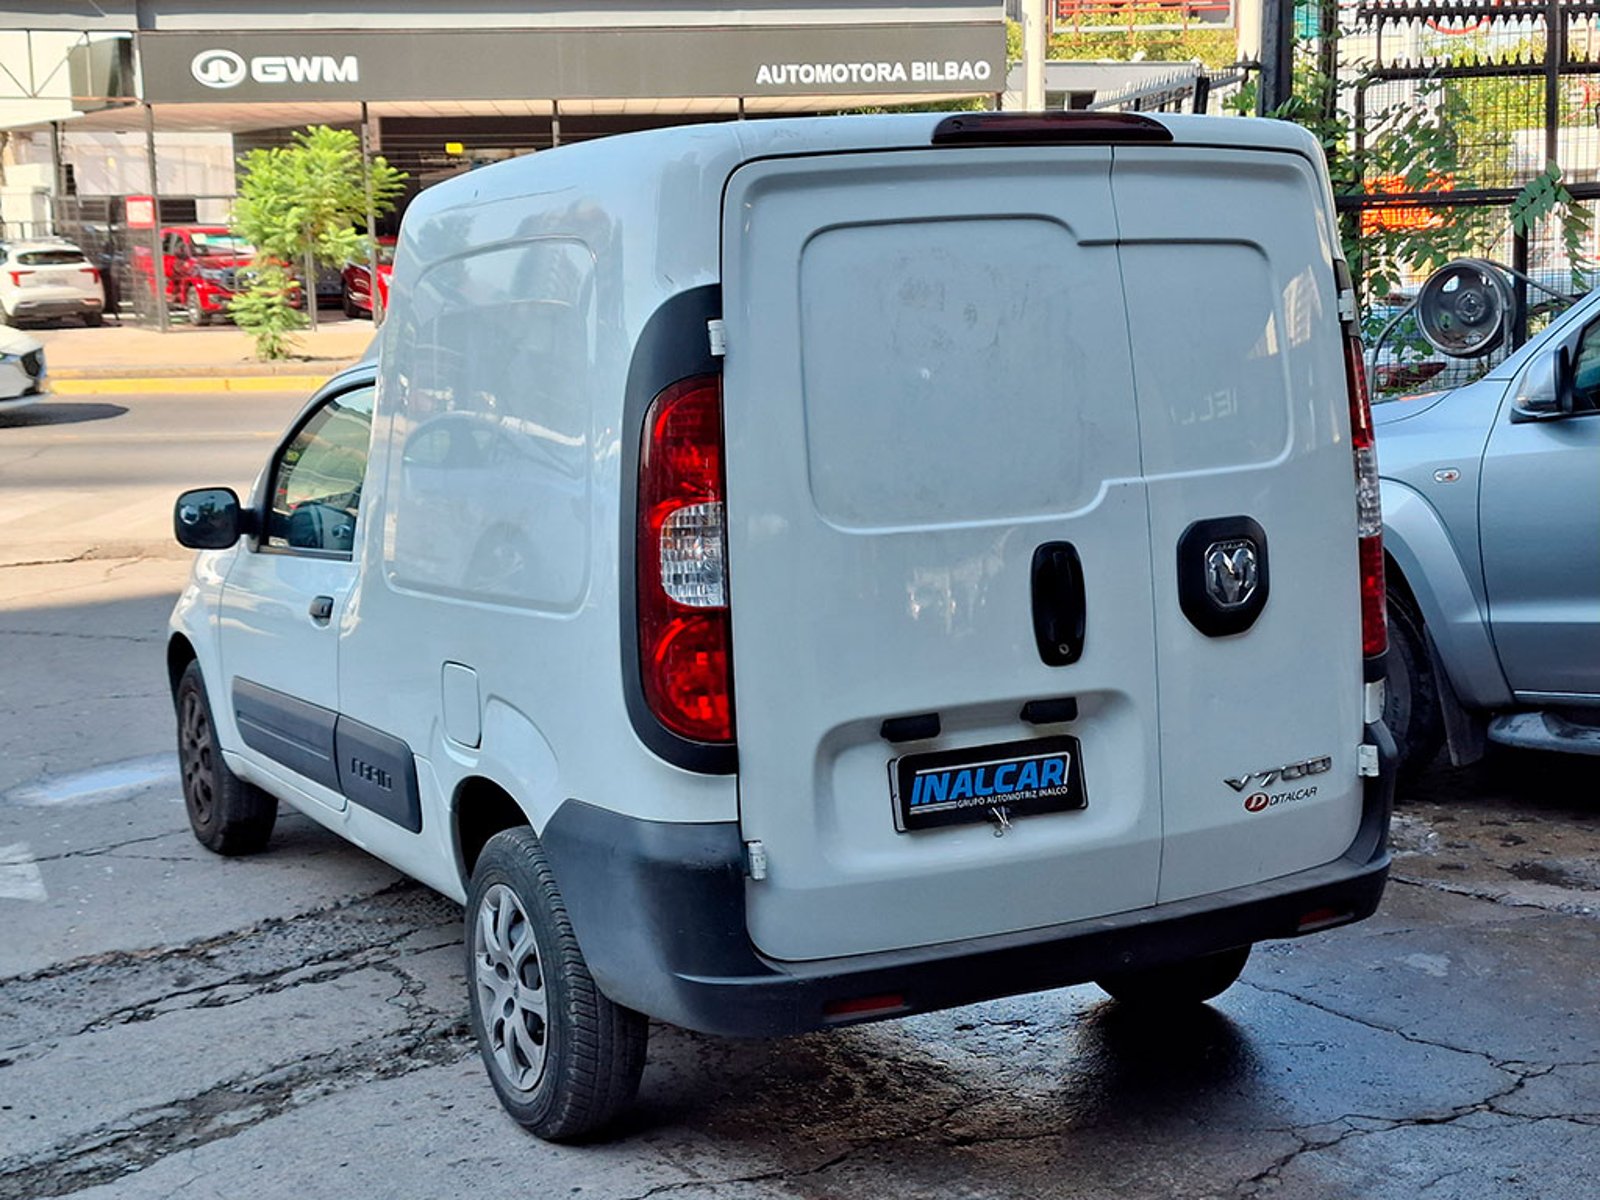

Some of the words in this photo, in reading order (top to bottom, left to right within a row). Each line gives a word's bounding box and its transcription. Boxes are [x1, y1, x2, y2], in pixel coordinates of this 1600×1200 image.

[251, 55, 358, 83] GWM
[755, 62, 907, 84] AUTOMOTORA
[911, 61, 991, 81] BILBAO
[911, 758, 1065, 806] INALCAR
[1224, 756, 1332, 793] V700
[957, 796, 985, 808] GRUPO
[987, 790, 1037, 804] AUTOMOTRIZ
[1038, 786, 1068, 798] INALCO
[1269, 786, 1318, 806] DITALCAR
